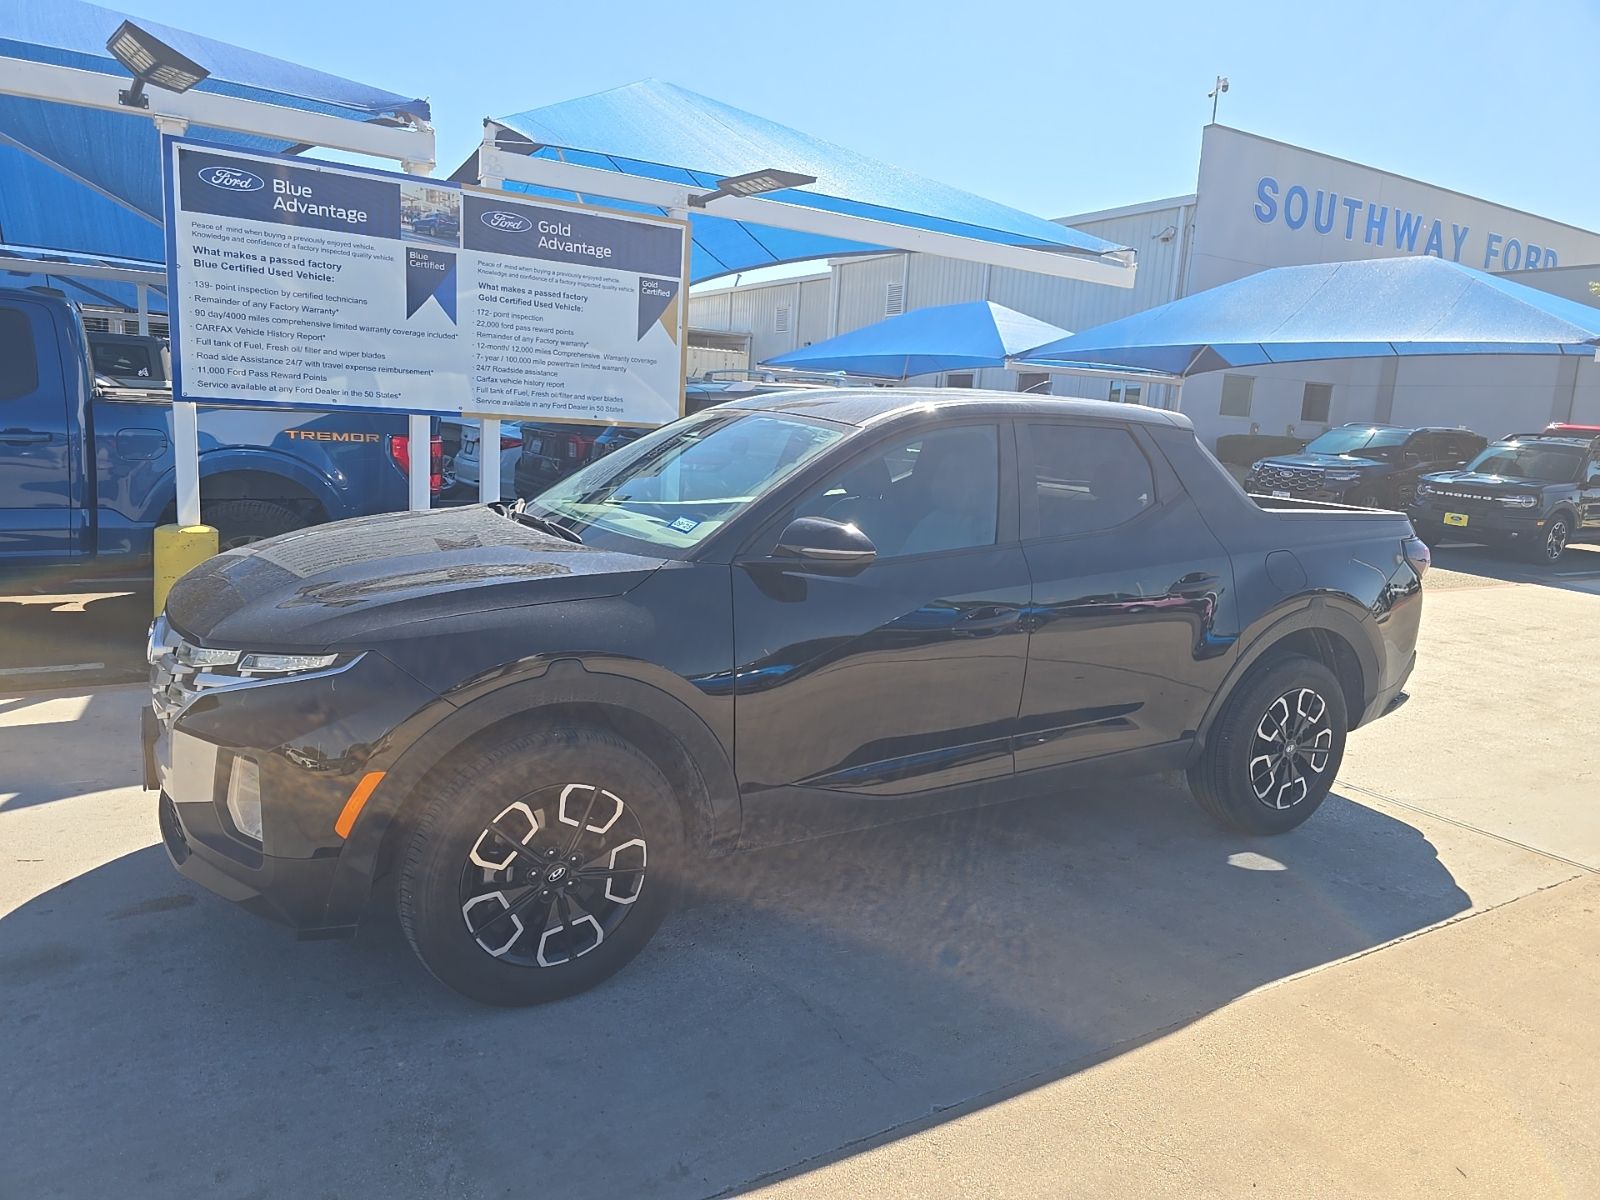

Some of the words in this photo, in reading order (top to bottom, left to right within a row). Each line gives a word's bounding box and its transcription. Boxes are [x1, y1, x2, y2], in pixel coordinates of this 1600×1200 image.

[212, 169, 252, 189] Ford
[273, 179, 312, 198] Blue
[274, 197, 367, 223] Advantage
[490, 213, 522, 230] Ford
[538, 220, 571, 236] Gold
[1254, 176, 1470, 263] SOUTHWAY
[1484, 232, 1559, 272] FORD
[191, 221, 214, 230] Peace
[244, 228, 263, 237] when
[264, 231, 286, 240] buying
[192, 230, 230, 242] Knowledge
[297, 244, 319, 254] factory
[320, 247, 351, 256] inspected
[538, 236, 611, 258] Advantage
[192, 245, 220, 256] What
[223, 251, 257, 260] makes
[269, 256, 305, 266] passed
[308, 259, 342, 272] factory
[410, 251, 428, 260] Blue
[193, 258, 218, 269] Blue
[221, 262, 265, 274] Certified
[268, 267, 293, 278] Used
[296, 271, 334, 282] Vehicle:
[409, 260, 445, 270] Certified
[478, 281, 499, 291] What
[500, 286, 526, 294] makes
[562, 292, 588, 303] factory
[641, 287, 670, 297] Certified
[642, 280, 658, 288] Gold
[215, 283, 236, 292] point
[238, 285, 279, 296] inspection
[281, 289, 291, 299] by
[292, 292, 324, 300] certified
[325, 294, 368, 305] technicians
[478, 294, 498, 303] Gold
[499, 296, 532, 306] Certified
[533, 300, 553, 309] Used
[194, 294, 240, 306] Remainder
[252, 302, 268, 310] any
[269, 302, 299, 313] Factory
[194, 308, 206, 318] 90
[248, 315, 270, 323] miles
[272, 318, 331, 328] comprehensive
[332, 322, 358, 332] limited
[359, 326, 391, 335] warranty
[392, 329, 425, 338] coverage
[476, 320, 500, 328] 22,000
[511, 314, 544, 322] inspection
[195, 323, 233, 333] CARFAX
[235, 326, 265, 336] Vehicle
[267, 330, 295, 340] History
[476, 331, 513, 340] Remainder
[535, 336, 559, 346] Factory
[196, 337, 212, 346] Full
[266, 343, 289, 352] Fresh
[361, 352, 386, 360] blades
[512, 345, 534, 354] 12,000
[196, 352, 219, 360] Road
[221, 354, 239, 362] side
[240, 356, 284, 365] Assistance
[285, 358, 303, 367] 24/7
[506, 356, 532, 364] 100,000
[197, 366, 225, 375] 11,000
[226, 368, 247, 376] Ford
[248, 369, 269, 378] Pass
[270, 371, 301, 380] Reward
[303, 373, 327, 381] Points
[492, 366, 524, 374] Roadside
[197, 380, 229, 389] Service
[231, 383, 267, 391] available
[295, 386, 313, 394] Ford
[315, 387, 340, 396] Dealer
[523, 379, 545, 387] history
[476, 397, 501, 405] Service
[552, 402, 567, 410] Ford
[285, 430, 380, 442] TREMOR
